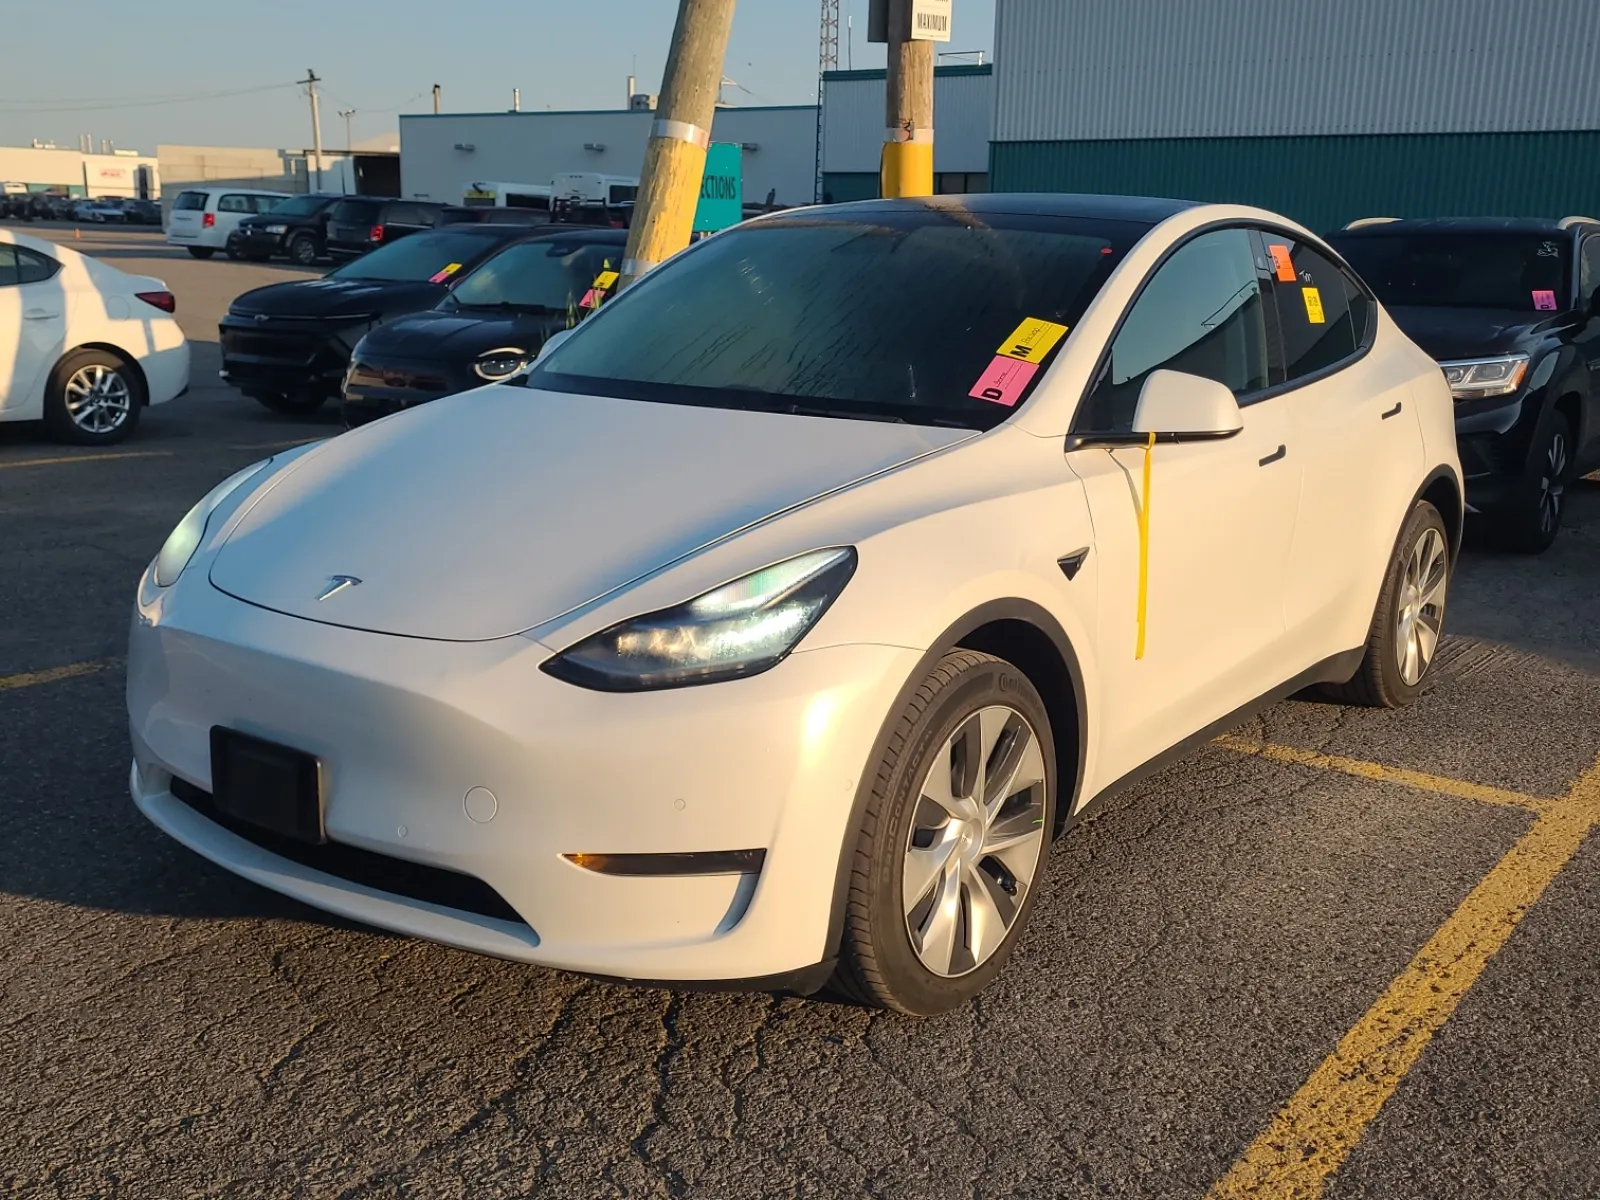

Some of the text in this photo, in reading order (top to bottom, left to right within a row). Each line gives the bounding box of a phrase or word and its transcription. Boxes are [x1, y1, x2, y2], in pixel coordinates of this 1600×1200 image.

[917, 13, 947, 31] MAXIMUM
[1009, 344, 1033, 358] M
[981, 387, 1003, 401] D
